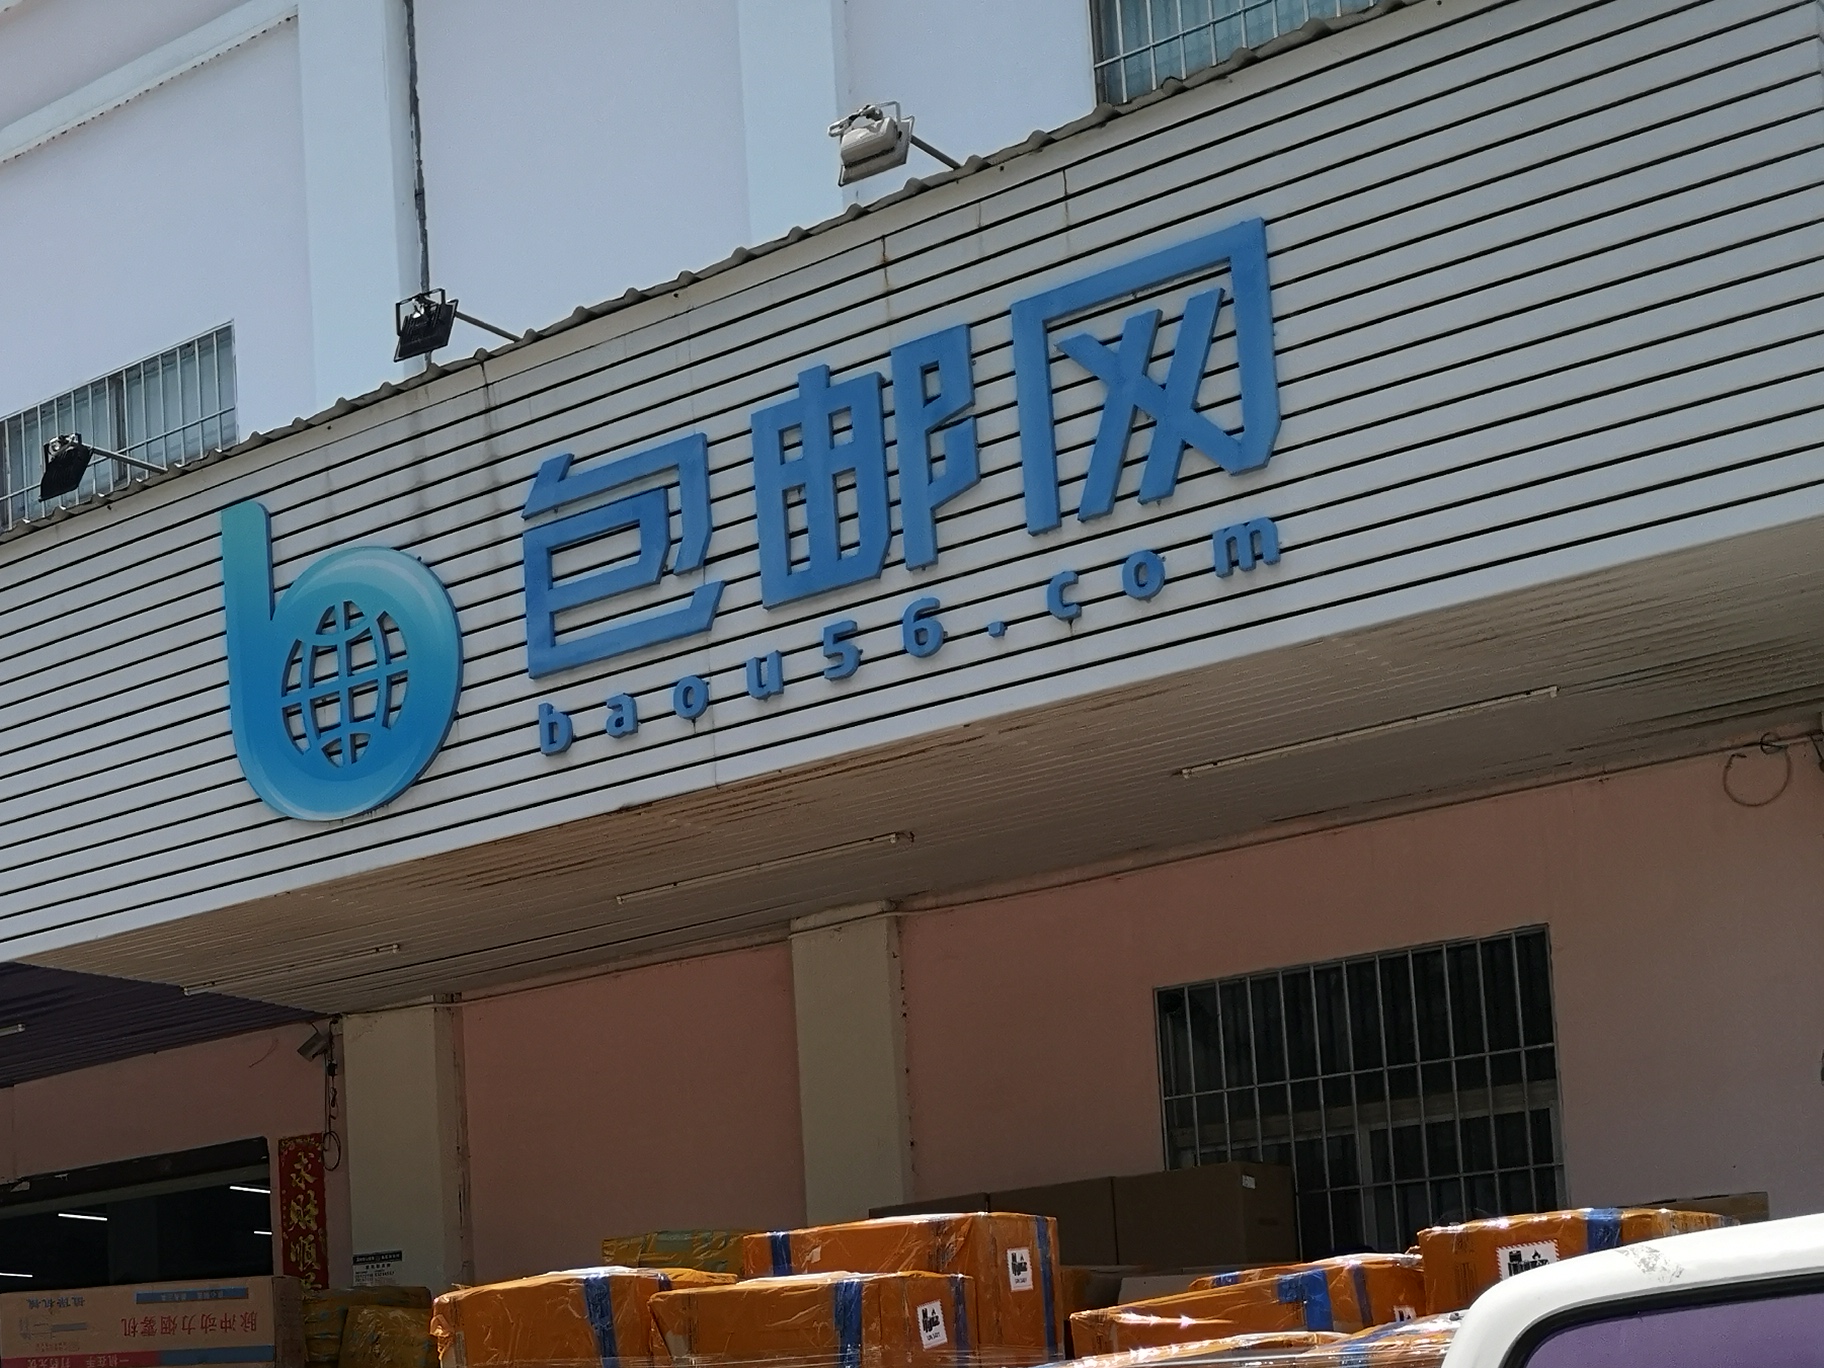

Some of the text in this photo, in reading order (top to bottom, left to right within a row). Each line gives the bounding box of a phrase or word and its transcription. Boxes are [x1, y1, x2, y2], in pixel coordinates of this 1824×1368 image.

[521, 216, 1282, 680] 包邮网
[538, 515, 1282, 757] baou56.com
[120, 1310, 258, 1338] 脉冲动力烟雾机
